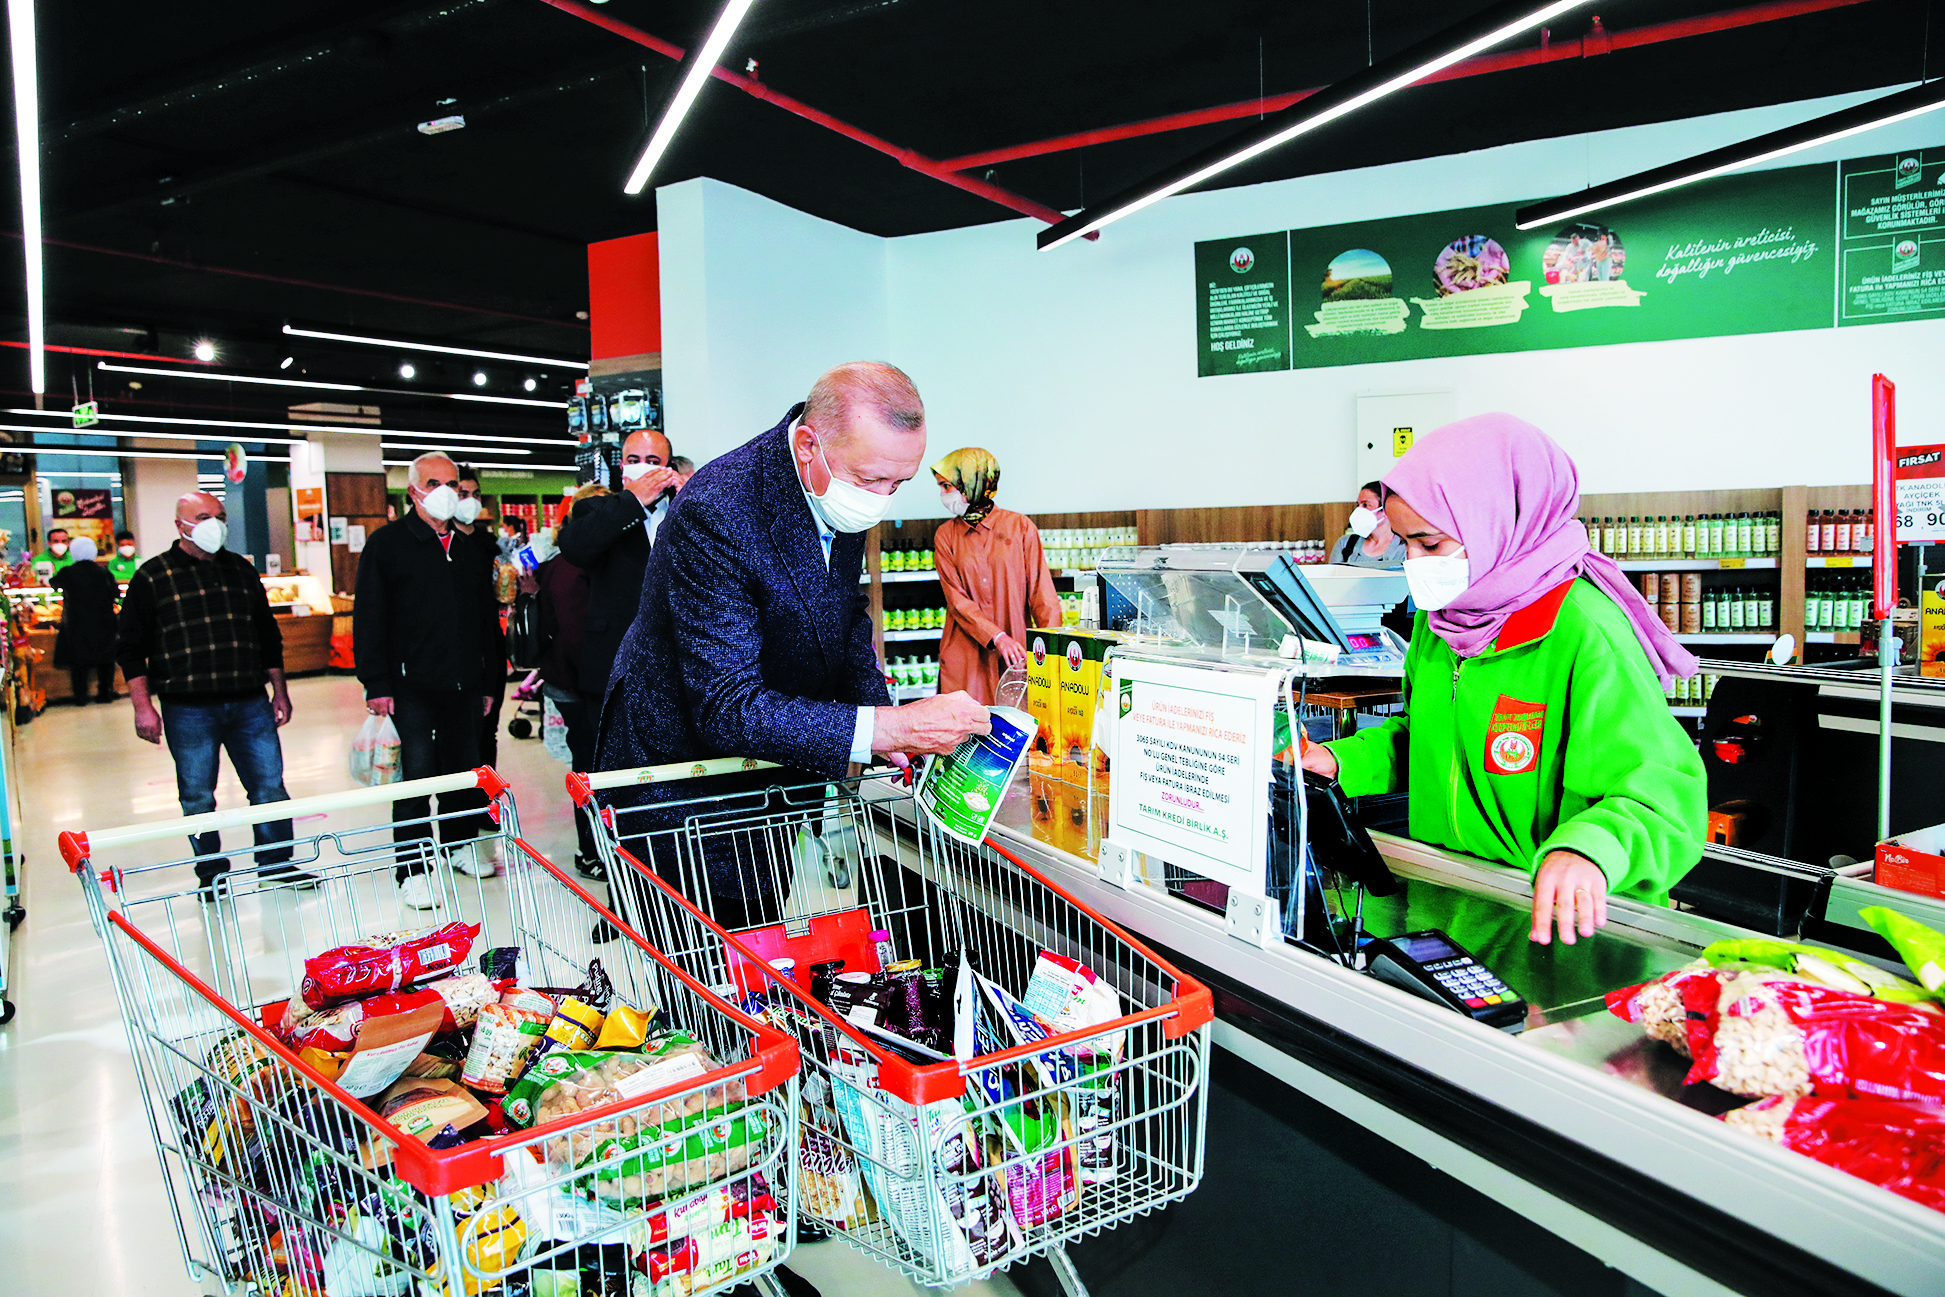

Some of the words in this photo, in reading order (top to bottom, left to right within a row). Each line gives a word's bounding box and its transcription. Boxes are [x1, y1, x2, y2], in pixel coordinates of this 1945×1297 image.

[1665, 239, 1731, 261] Kalitenin
[1734, 226, 1796, 249] üreticisi,
[1655, 257, 1725, 284] doğallığın
[1724, 240, 1819, 275] güvencesiyiz.
[1210, 341, 1224, 353] HOŞ
[1225, 337, 1255, 350] GELDİNİZ
[1898, 451, 1941, 468] FIRSAT
[1904, 491, 1941, 500] AYÇİÇEK
[1908, 482, 1945, 491] ANADOL
[1916, 499, 1933, 507] TNK
[1151, 700, 1167, 713] ÜRÜN
[1205, 710, 1215, 724] FİŞ
[1133, 712, 1146, 724] VEYE
[1146, 714, 1166, 728] FATURA
[1167, 717, 1175, 730] İLE
[1176, 720, 1208, 736] YAPMANIZI
[1208, 726, 1223, 740] RİCA
[1224, 729, 1246, 745] EDERİZ
[1136, 733, 1149, 744] 3065
[1149, 736, 1166, 749] SAYILI
[1166, 740, 1178, 751] KDV
[1179, 743, 1217, 760] KANUNUNUN
[1218, 752, 1226, 762] 54
[1226, 754, 1240, 766] SERİ
[1155, 761, 1171, 775] ÜRÜN
[1172, 764, 1209, 785] İADELERİNDE
[1161, 752, 1178, 764] GENEL
[1179, 755, 1208, 772] TEBLİĞİNE
[1208, 763, 1226, 776] GÖRE
[1139, 771, 1148, 783] FİŞ
[1148, 773, 1162, 785] VEYA
[1162, 777, 1183, 791] FATURA
[1184, 781, 1202, 797] İBRAZ
[1202, 787, 1230, 804] EDİLMESİ
[1138, 803, 1161, 818] TARIM
[1162, 810, 1185, 826] KREDİ
[1186, 817, 1212, 834] BİRLİK
[1212, 826, 1229, 841] A.Ş.
